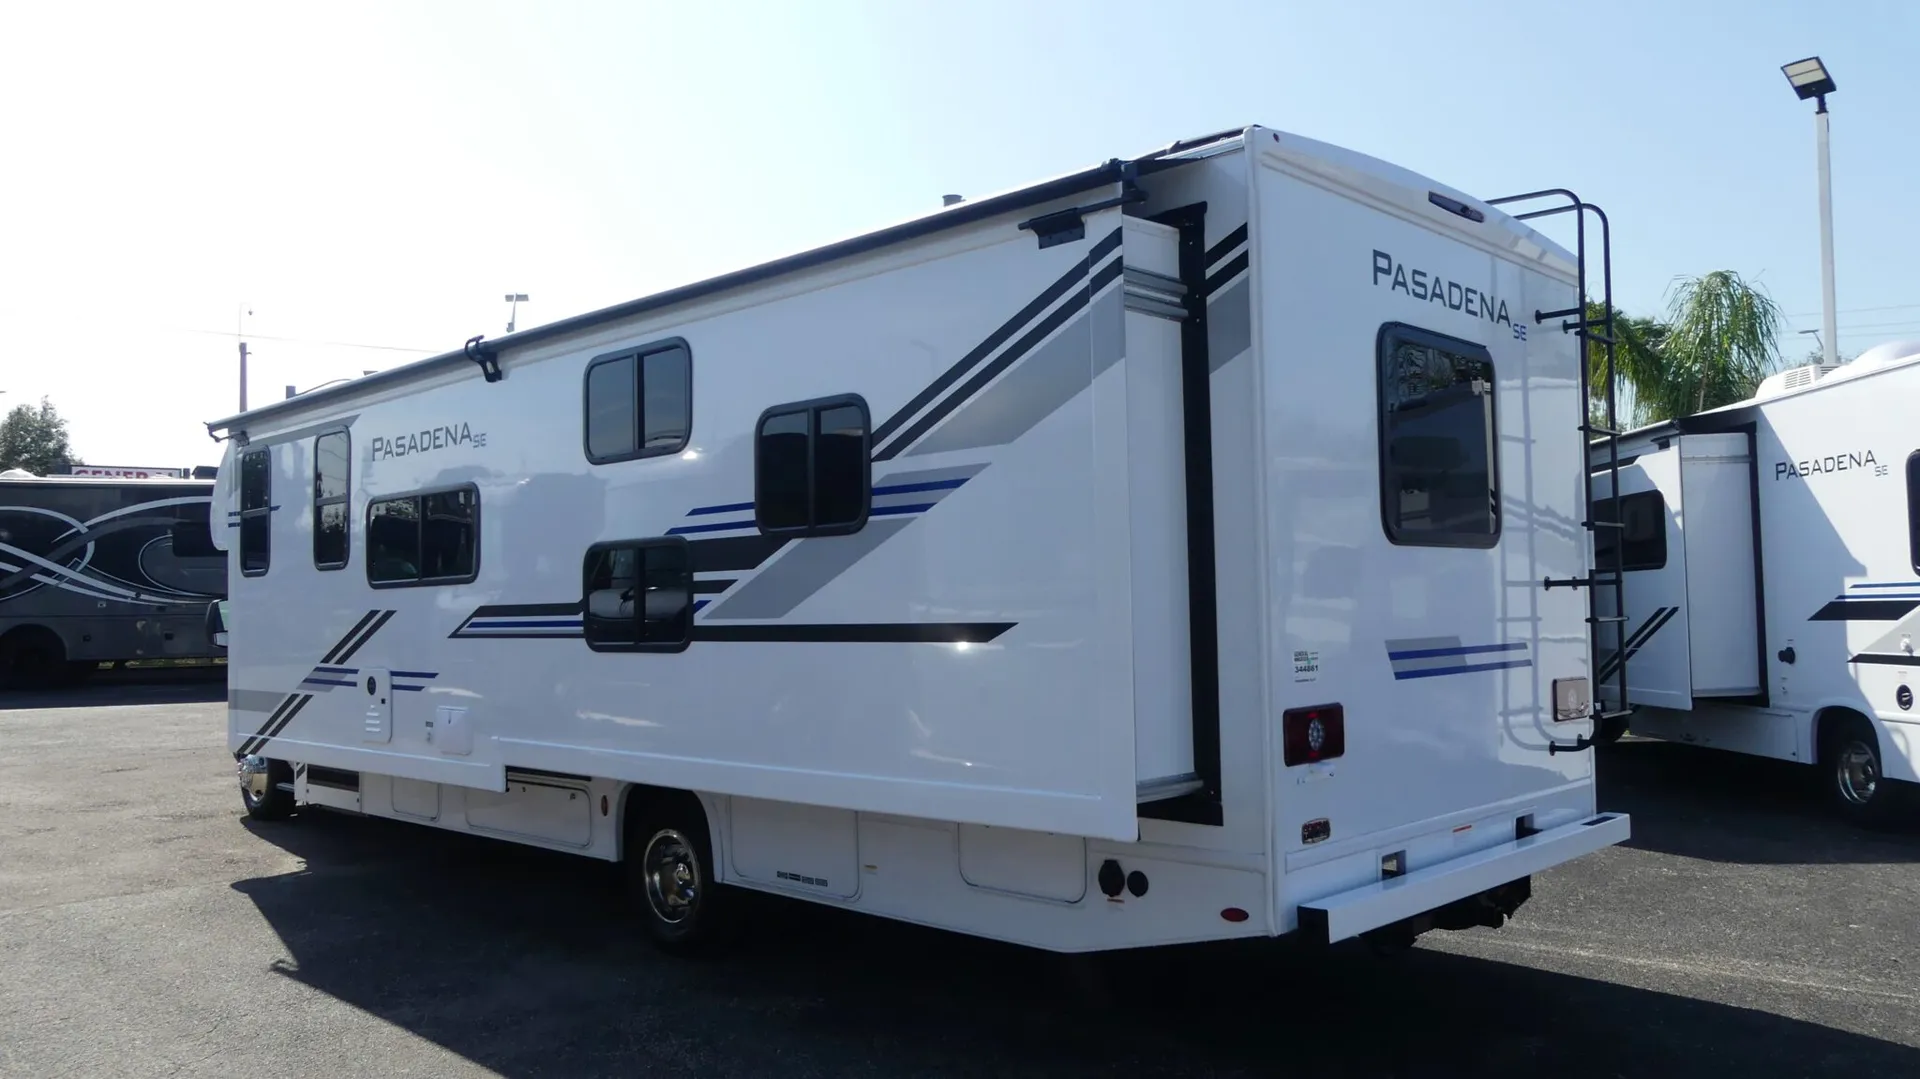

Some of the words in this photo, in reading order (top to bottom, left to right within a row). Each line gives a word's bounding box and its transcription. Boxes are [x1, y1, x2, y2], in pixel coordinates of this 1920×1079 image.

[1373, 249, 1511, 328] PASADENA
[1513, 323, 1527, 341] SE
[372, 421, 472, 461] PASADENA
[473, 433, 486, 448] SE
[1775, 449, 1877, 480] PASADENA
[1874, 465, 1888, 476] SE
